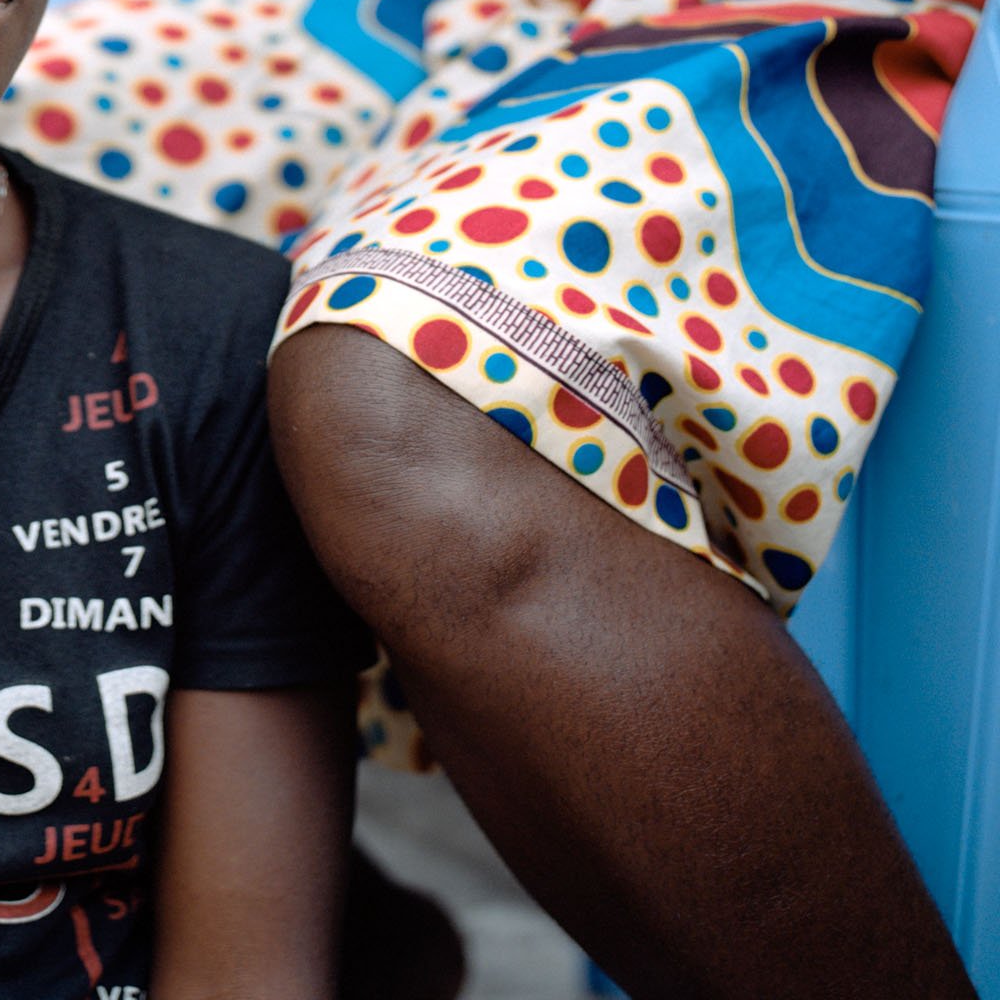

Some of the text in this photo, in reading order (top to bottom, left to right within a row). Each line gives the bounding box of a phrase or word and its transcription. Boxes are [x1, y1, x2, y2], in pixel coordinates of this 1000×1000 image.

[104, 460, 130, 492] 5
[121, 546, 146, 578] 7
[19, 595, 174, 632] DIMAN
[96, 665, 170, 802] D
[72, 766, 106, 803] 4
